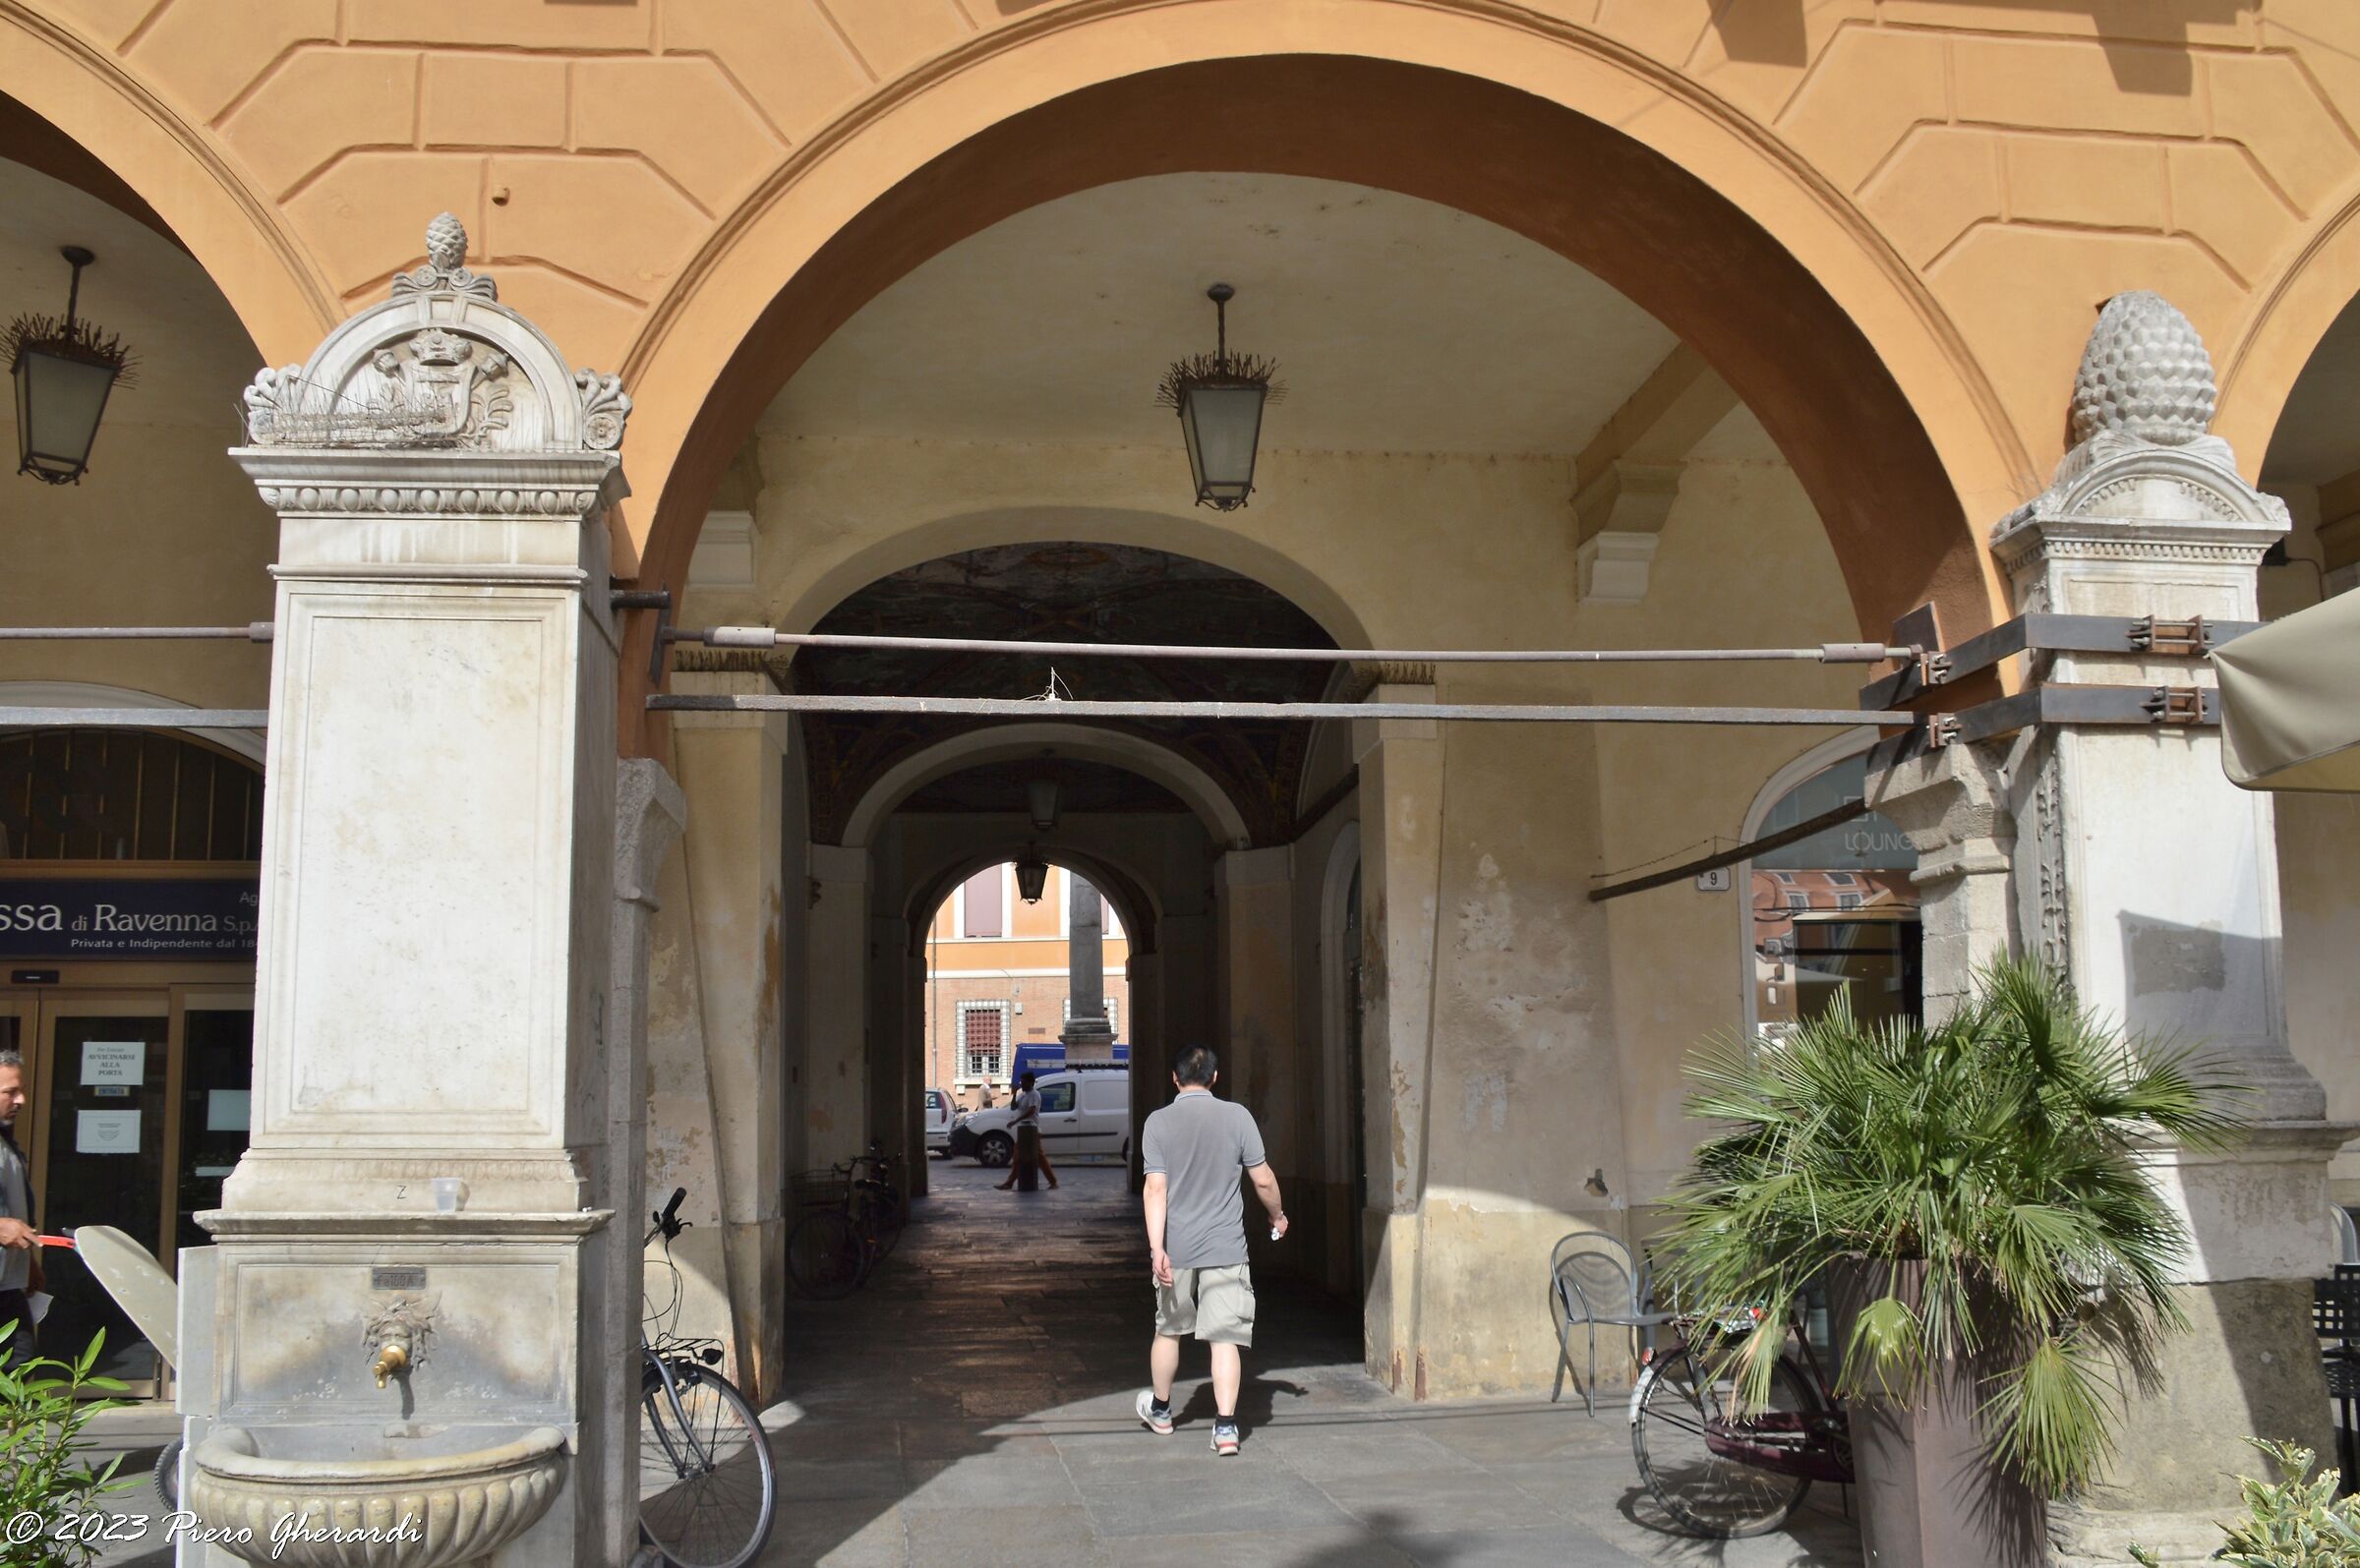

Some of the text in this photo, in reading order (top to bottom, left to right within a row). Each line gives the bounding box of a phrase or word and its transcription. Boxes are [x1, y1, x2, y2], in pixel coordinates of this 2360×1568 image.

[1710, 871, 1717, 886] 9
[71, 914, 88, 931] di
[93, 903, 217, 932] Ravenna
[71, 938, 113, 948] Privata
[129, 938, 212, 951] Indipendente
[216, 938, 235, 948] dal
